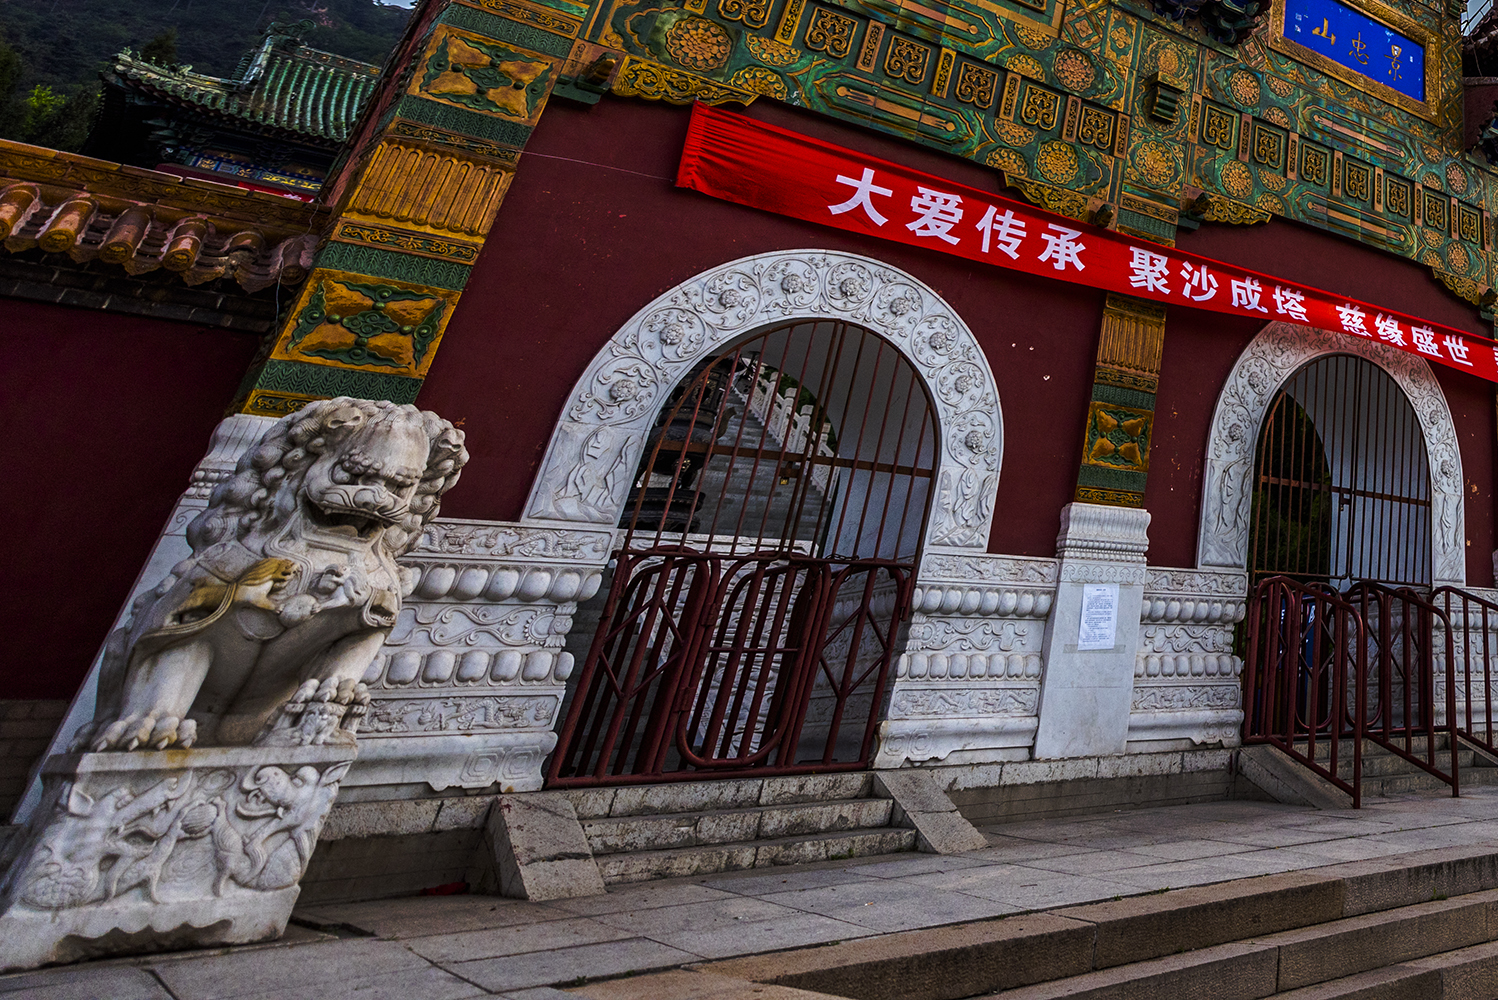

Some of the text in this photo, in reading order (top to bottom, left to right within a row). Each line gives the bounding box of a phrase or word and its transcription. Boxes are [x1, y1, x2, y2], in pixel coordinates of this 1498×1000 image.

[828, 168, 1086, 271] 大爱传承
[1129, 246, 1310, 322] 聚沙成塔
[1335, 303, 1473, 366] 慈缘盛世
